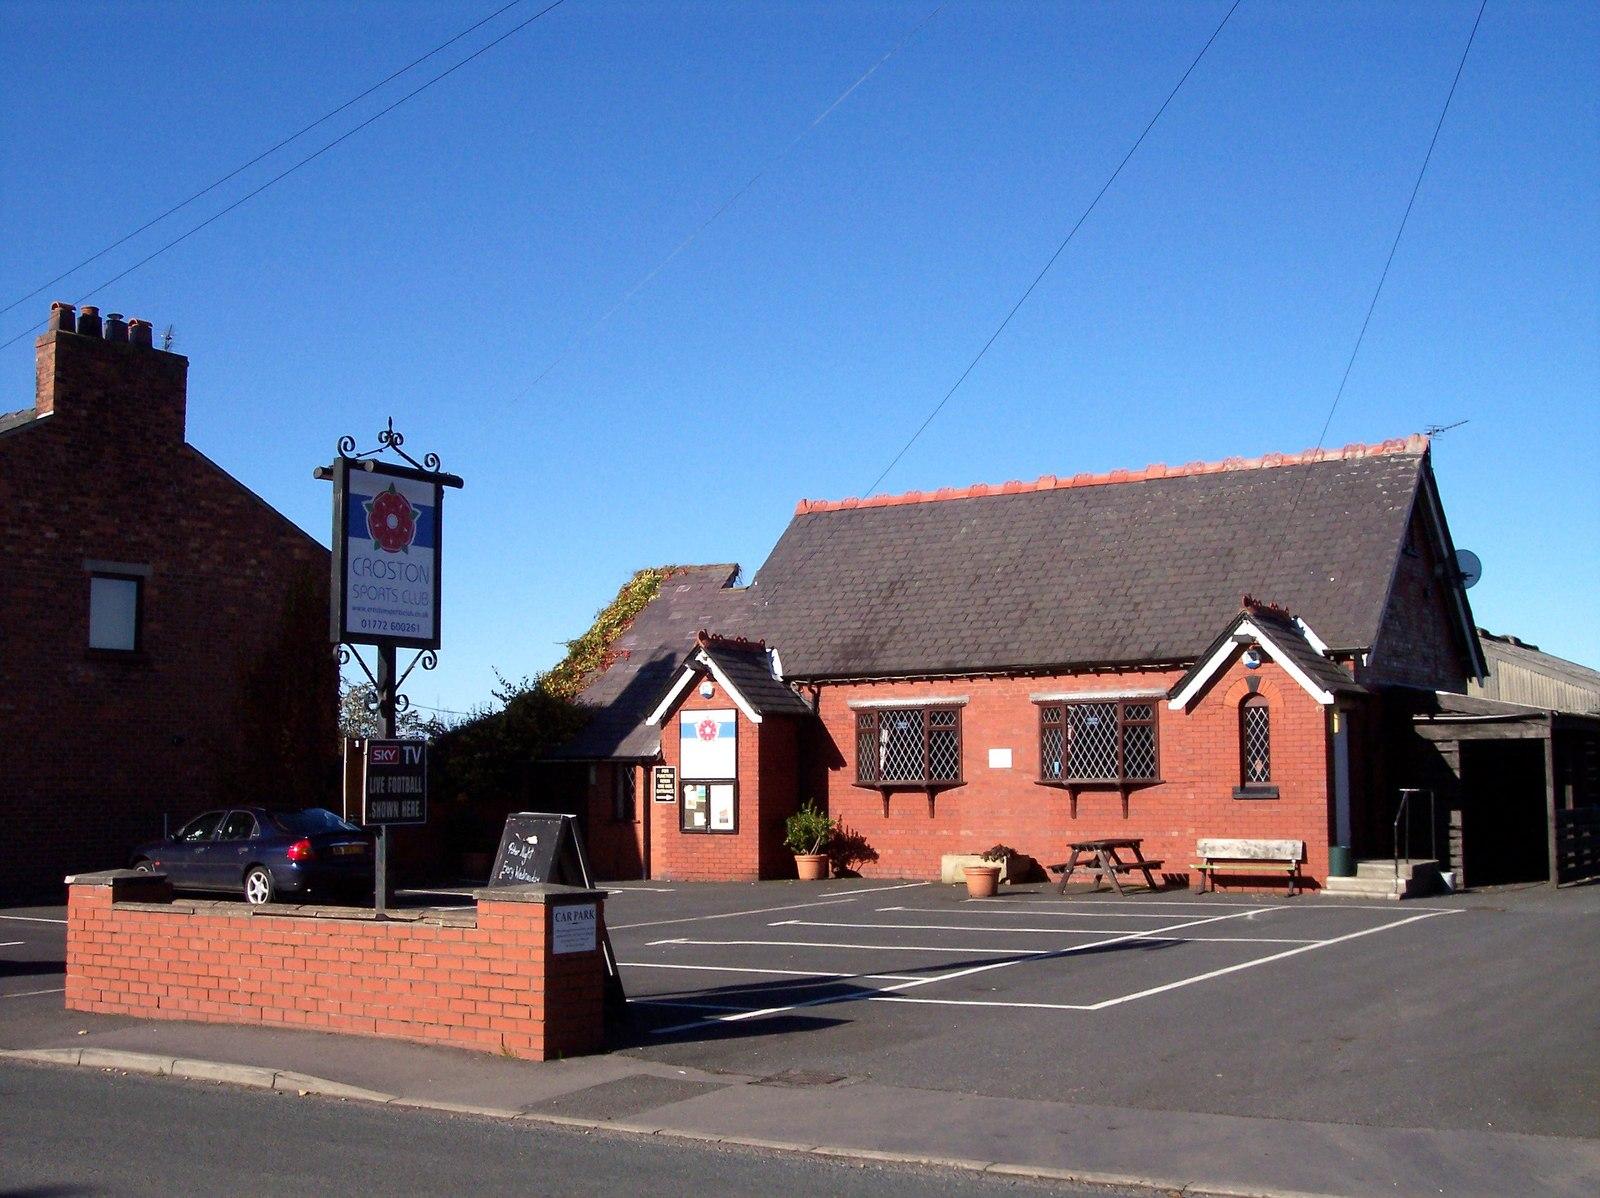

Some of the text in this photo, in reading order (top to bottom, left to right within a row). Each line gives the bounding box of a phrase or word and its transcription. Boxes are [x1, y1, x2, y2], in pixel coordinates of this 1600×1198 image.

[353, 558, 429, 584] CROSTON
[352, 584, 429, 606] SPORTS CLUB
[361, 618, 387, 630] 01772
[373, 745, 422, 765] SKY TV
[369, 775, 422, 794] LIVE FOOTBALL
[371, 800, 420, 818] SHOWN HERE
[555, 908, 596, 922] CAR PARK
